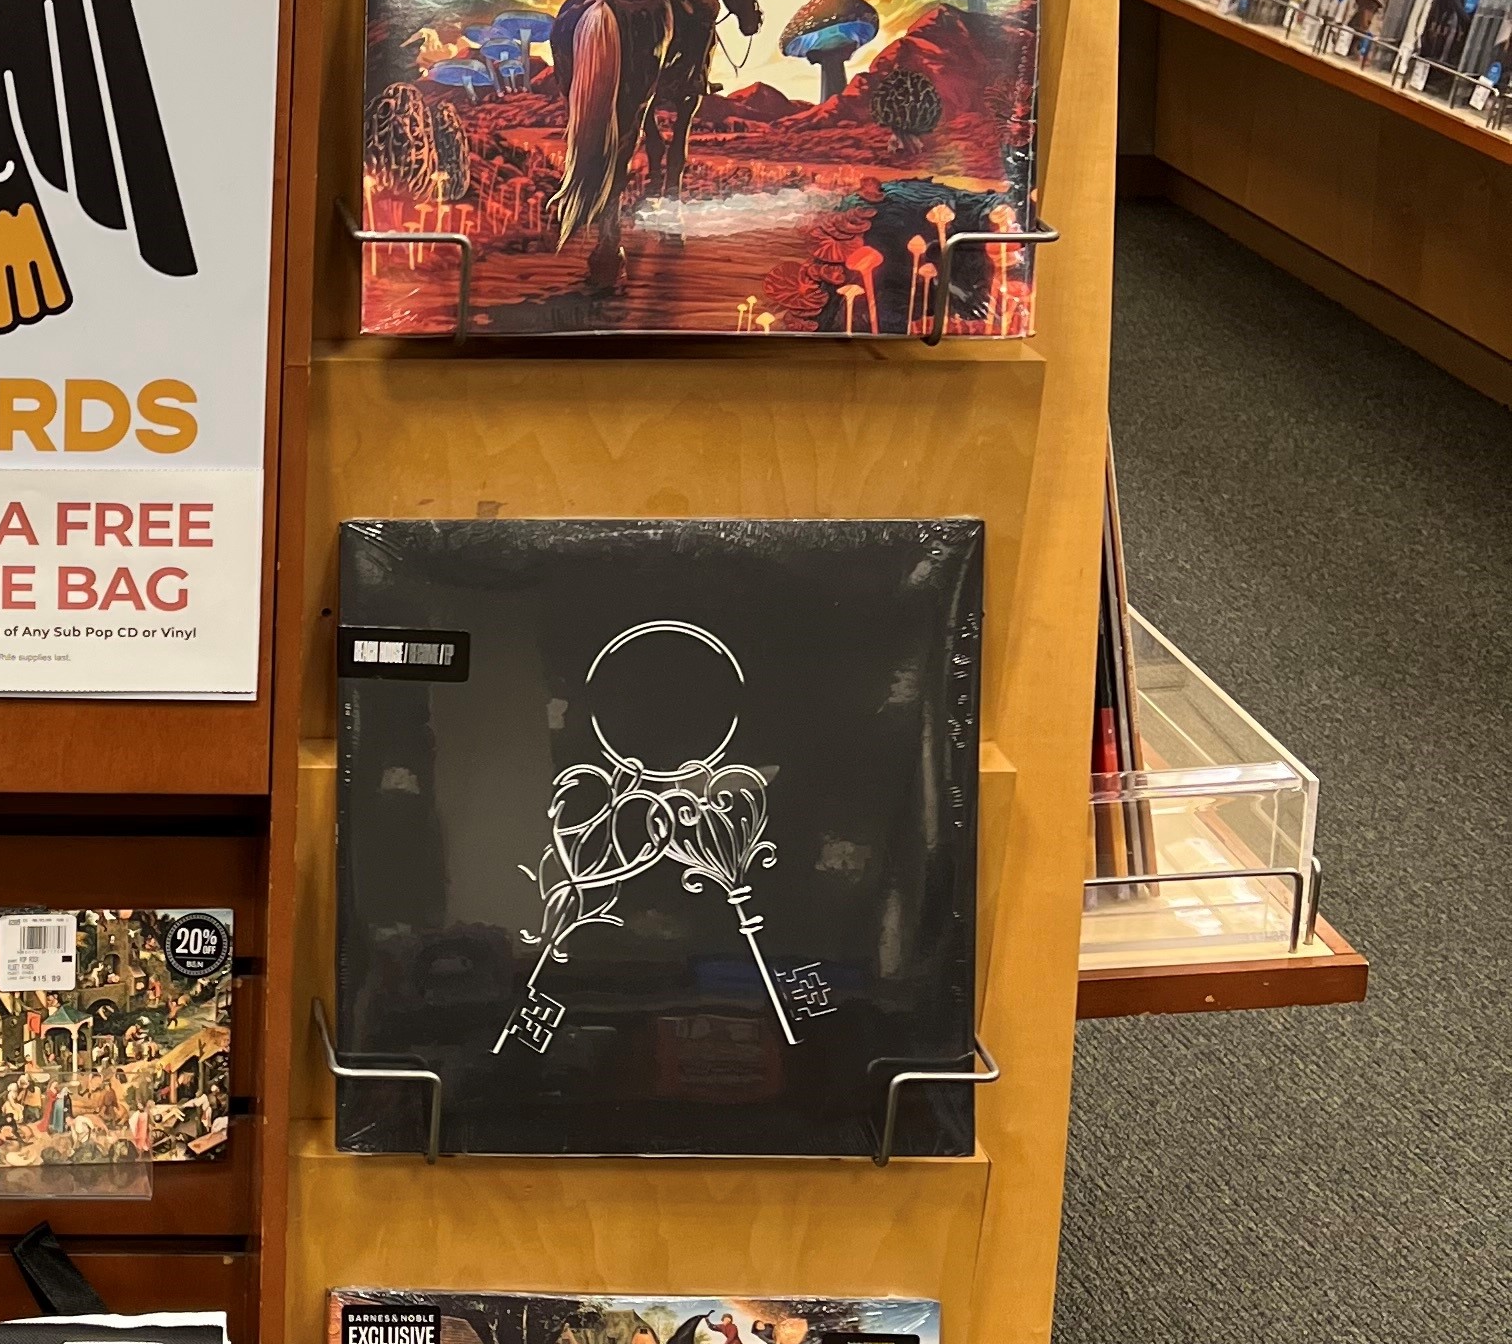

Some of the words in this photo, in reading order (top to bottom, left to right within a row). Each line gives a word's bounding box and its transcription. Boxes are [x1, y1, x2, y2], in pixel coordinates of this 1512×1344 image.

[56, 501, 215, 548] FREE
[56, 565, 190, 613] BAG
[3, 624, 19, 638] of
[21, 626, 50, 641] Any
[53, 626, 81, 638] Sub
[85, 627, 113, 641] Pop
[117, 627, 138, 639] CD
[142, 629, 157, 639] or
[160, 627, 198, 641] Vinyl
[175, 927, 218, 955] 20%
[202, 945, 217, 956] OFF
[348, 1314, 391, 1323] BARNES
[400, 1314, 435, 1323] NOBLE
